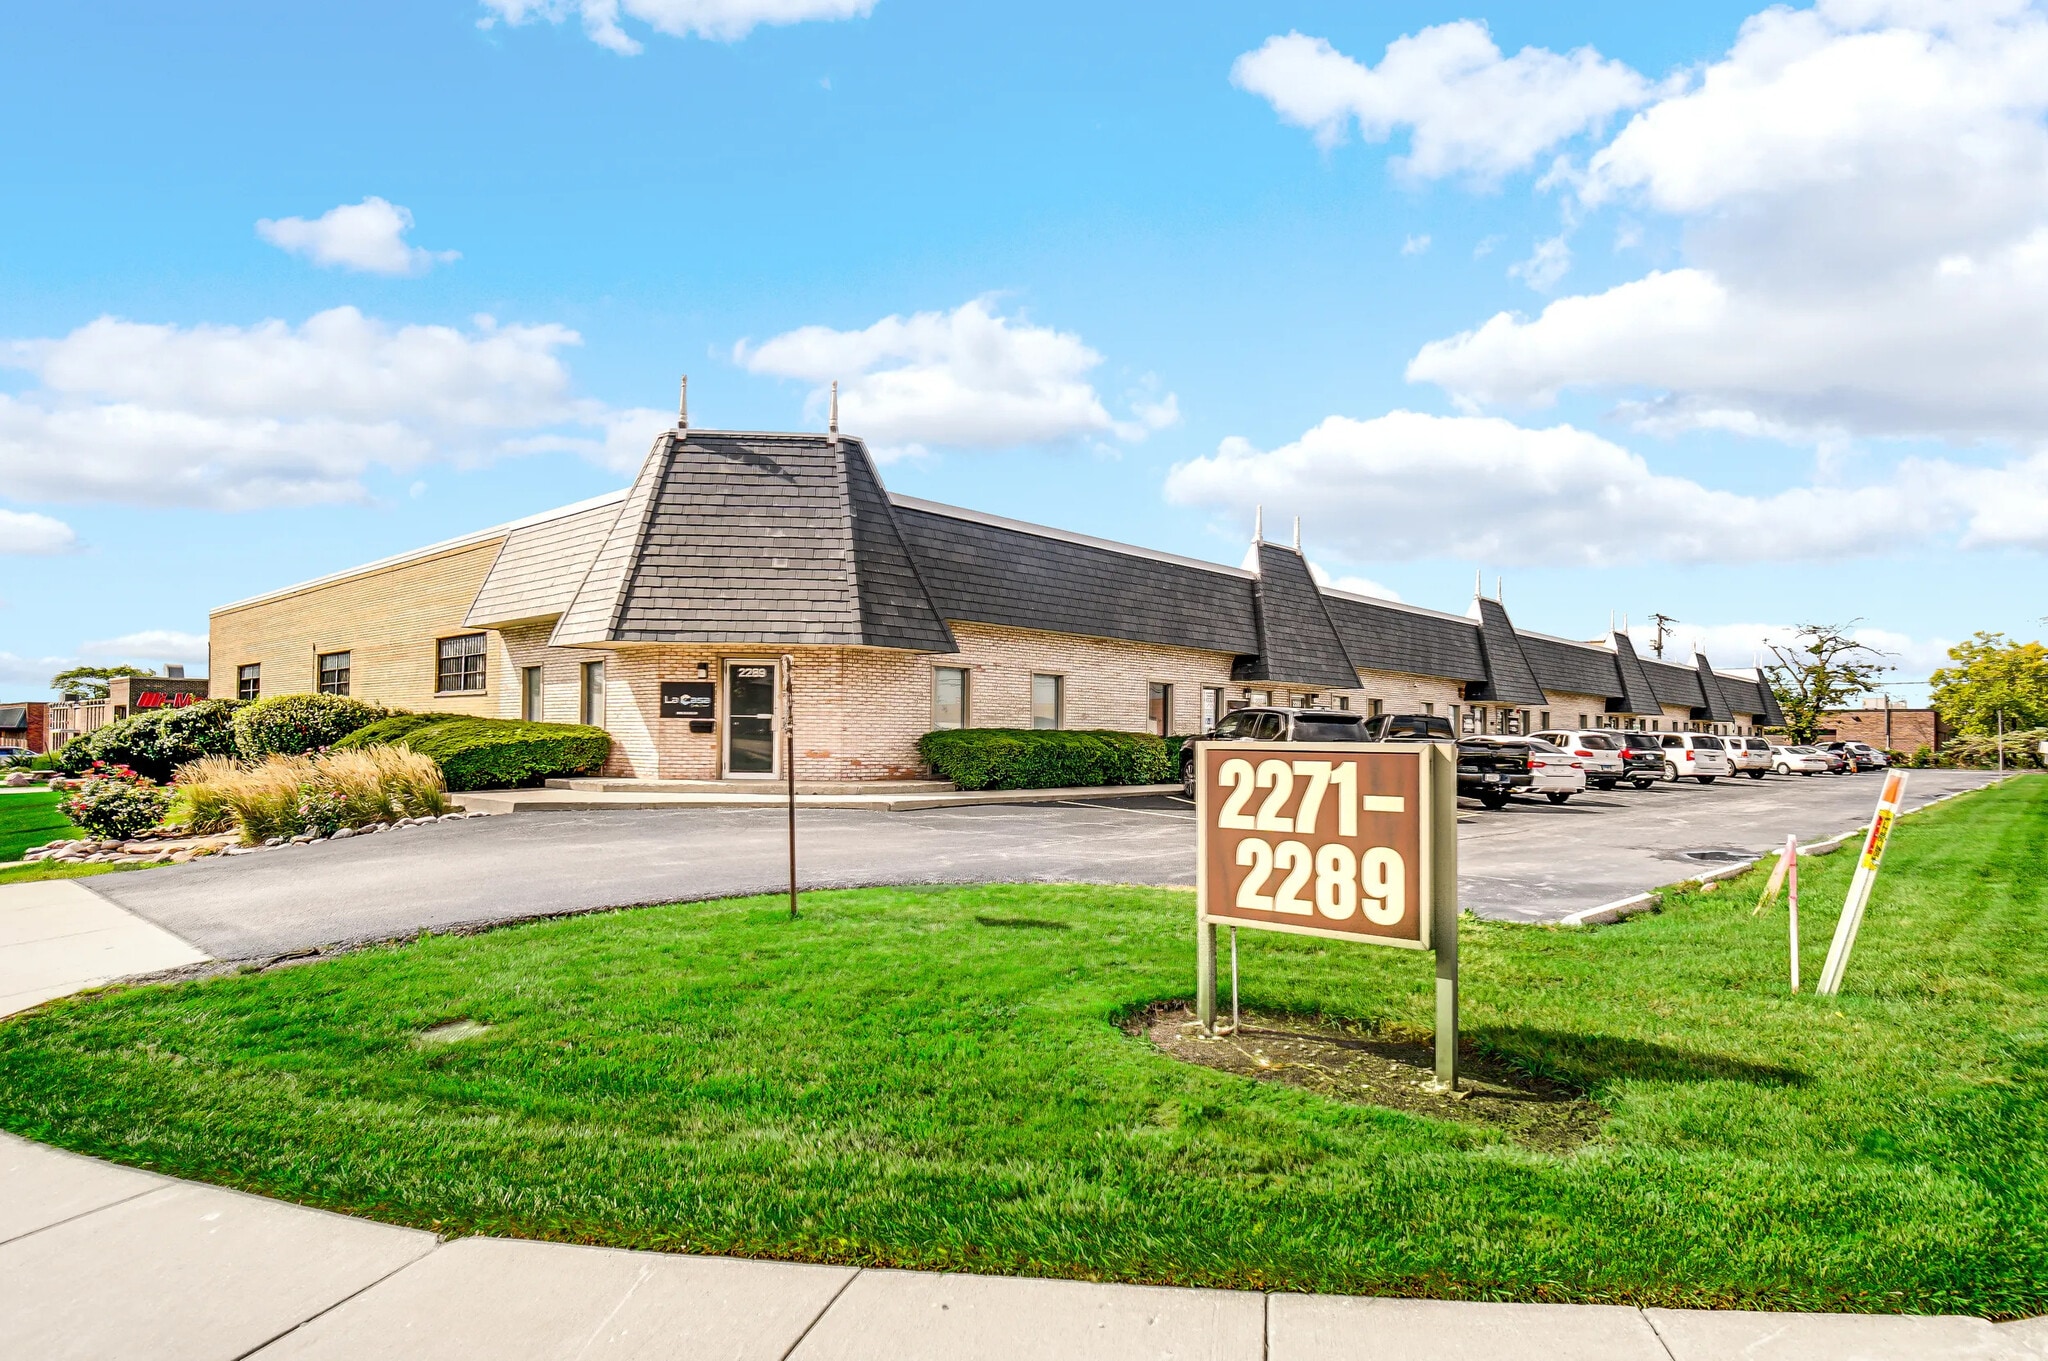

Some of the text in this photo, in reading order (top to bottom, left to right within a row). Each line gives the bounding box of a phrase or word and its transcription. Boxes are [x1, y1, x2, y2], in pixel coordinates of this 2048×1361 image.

[738, 667, 767, 678] 2289
[1218, 758, 1405, 837] 2271-
[1235, 837, 1406, 926] 2289
